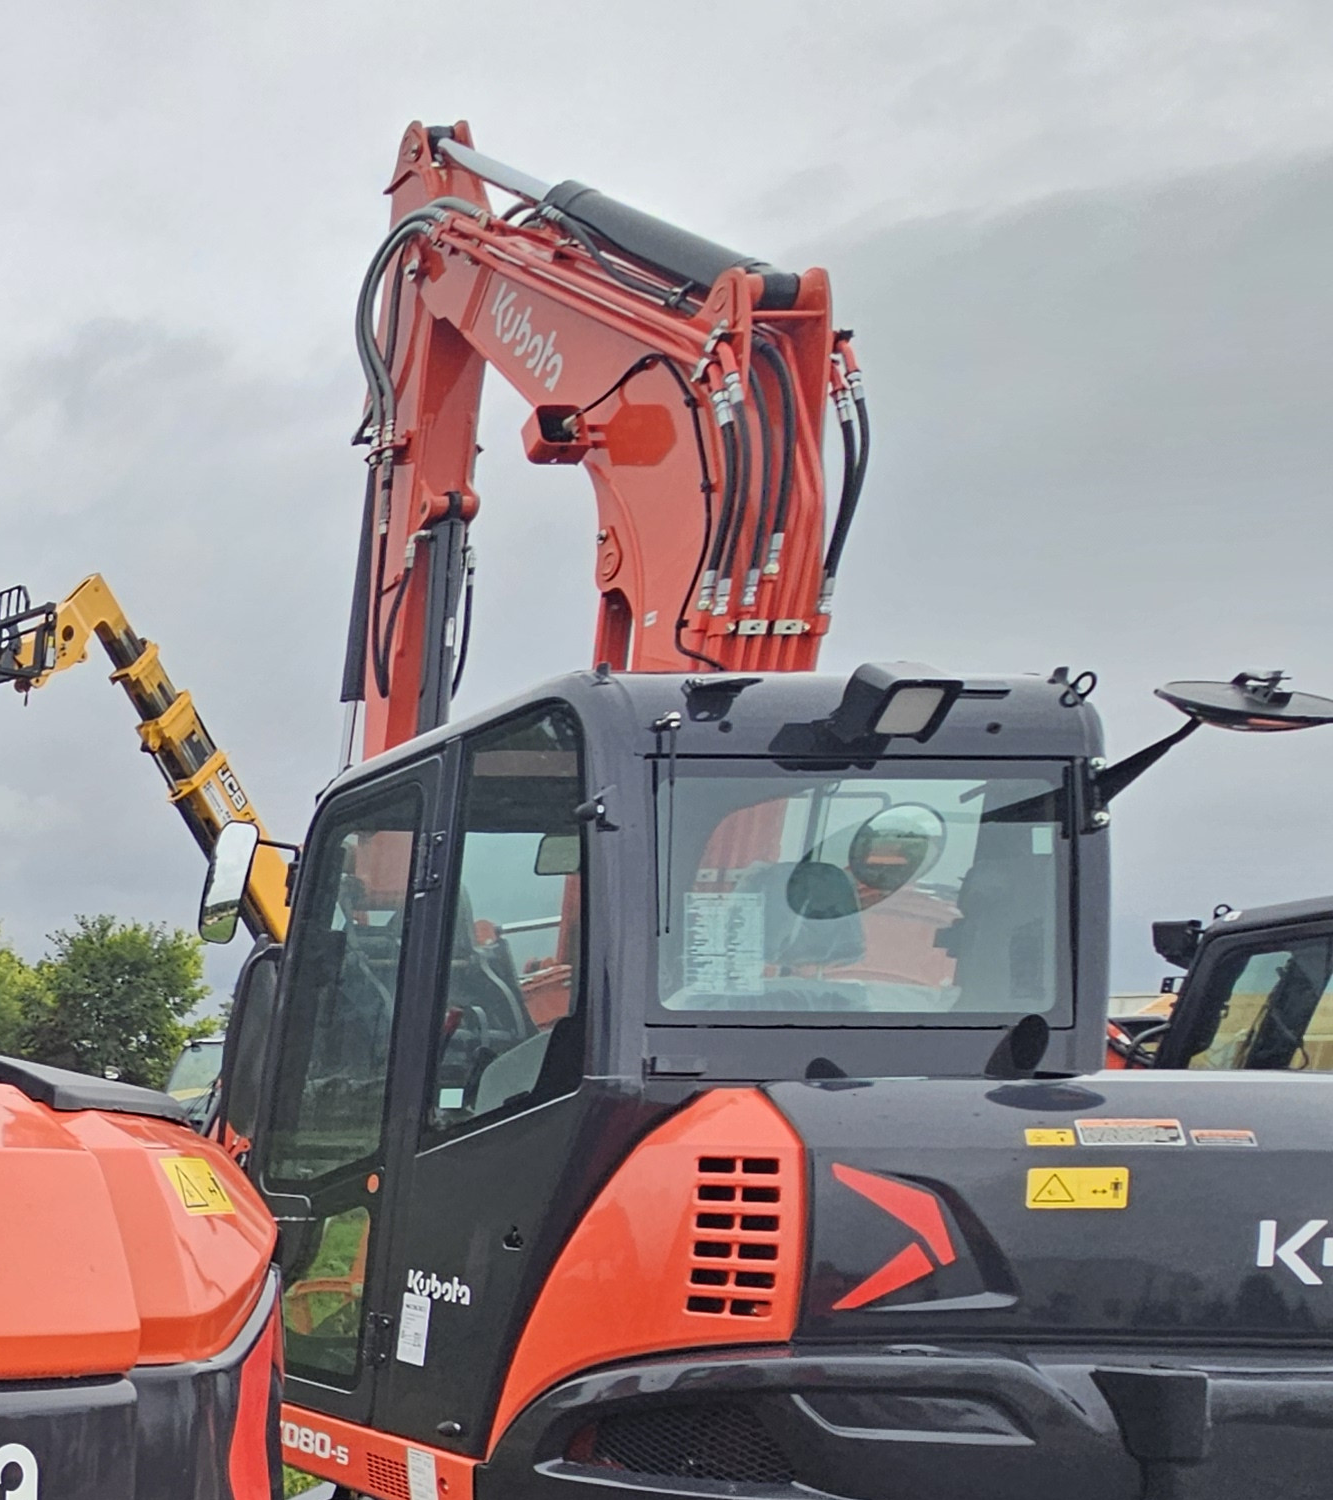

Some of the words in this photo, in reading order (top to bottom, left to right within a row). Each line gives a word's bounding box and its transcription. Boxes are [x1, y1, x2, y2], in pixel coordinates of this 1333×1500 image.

[490, 281, 564, 392] Kubota
[217, 762, 248, 812] JCB
[407, 1268, 471, 1306] Kubota
[280, 1420, 349, 1466] 080-5
